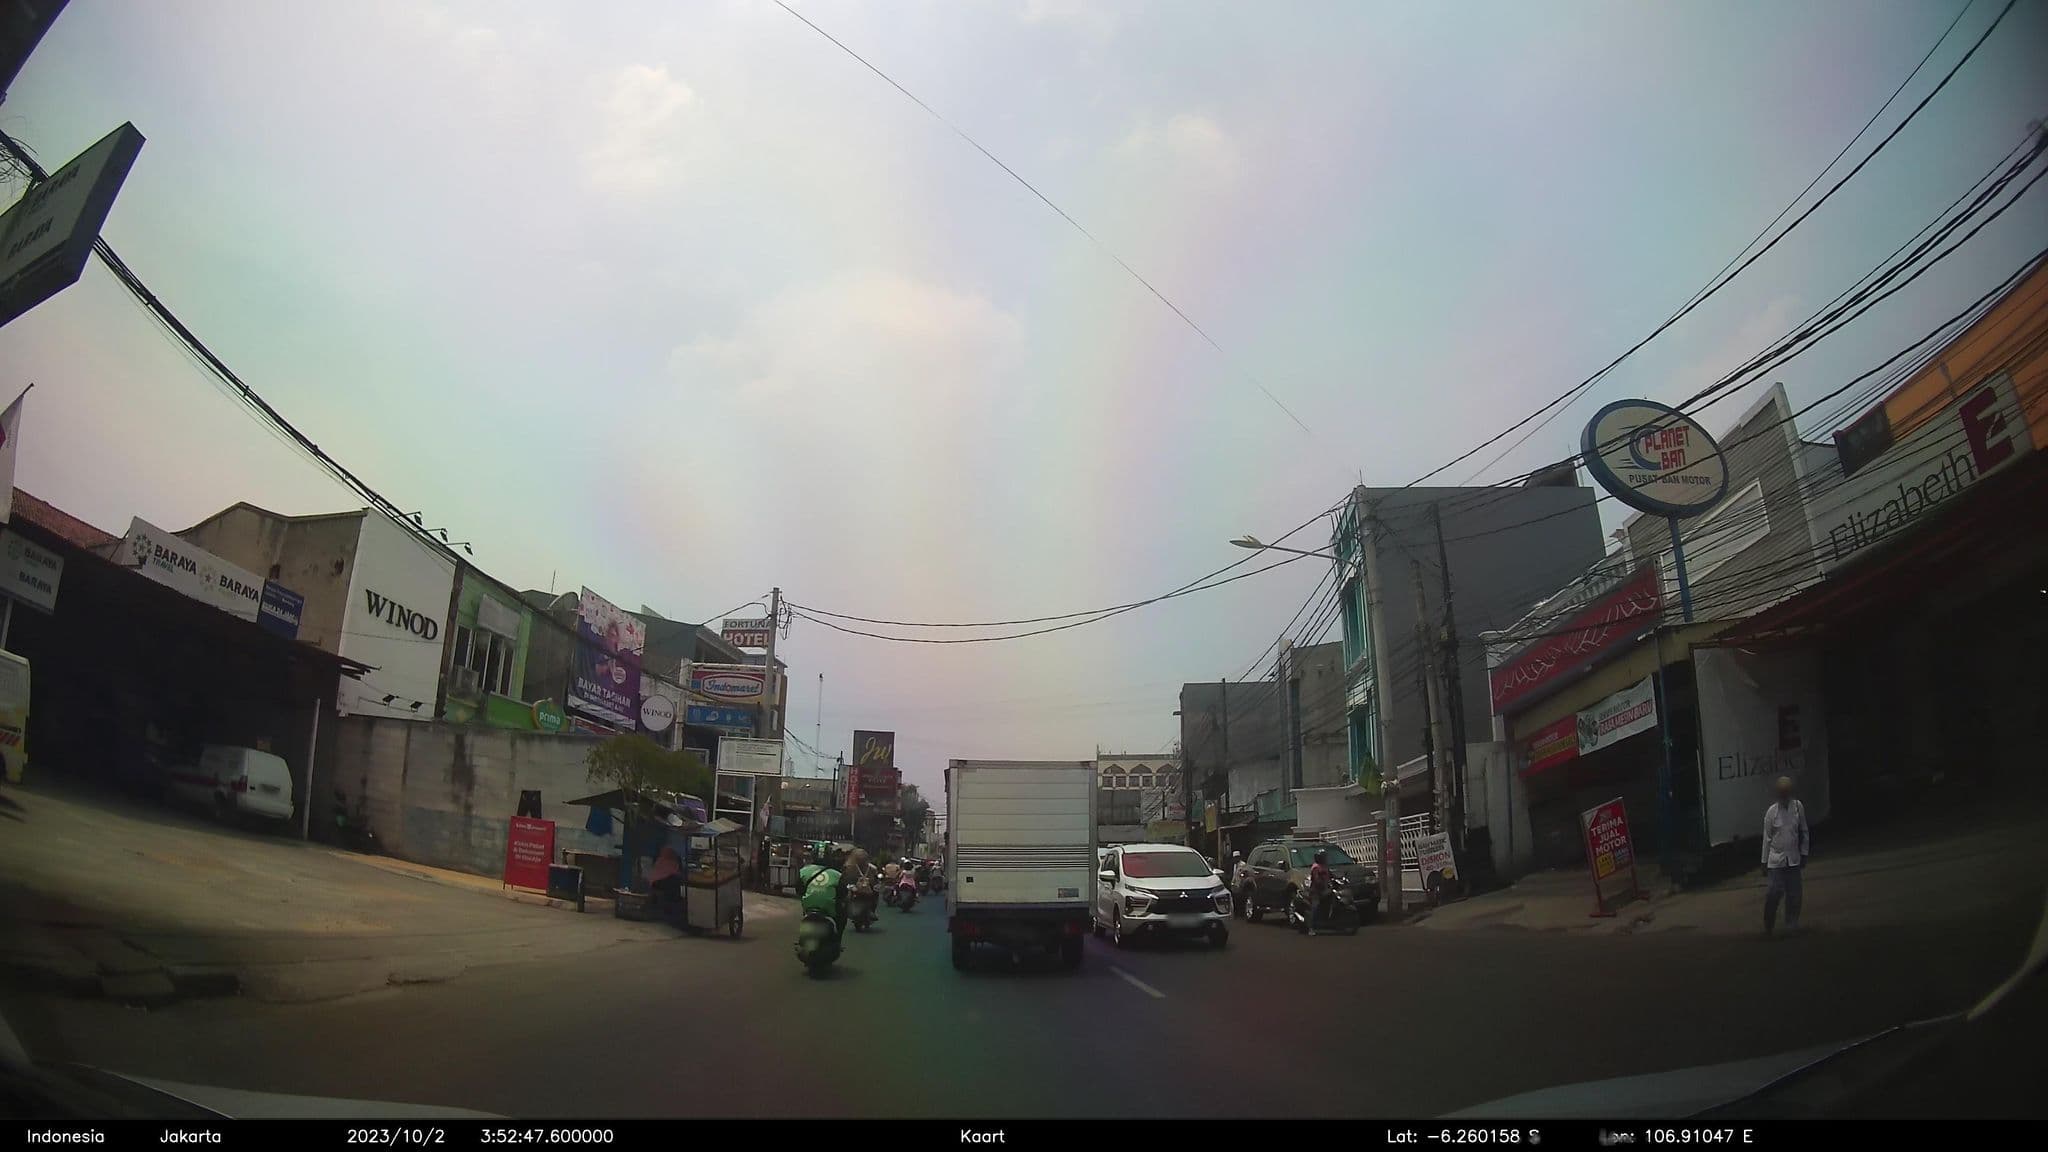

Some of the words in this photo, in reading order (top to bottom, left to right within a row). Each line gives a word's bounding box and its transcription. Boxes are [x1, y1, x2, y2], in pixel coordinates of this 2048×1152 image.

[1644, 425, 1690, 454] PLANET
[1661, 448, 1687, 470] BAN
[1628, 474, 1658, 484] PUSAT
[1661, 474, 1681, 485] BAN
[1681, 475, 1712, 487] MOTOR
[1829, 452, 1976, 562] Elizabeth
[153, 544, 197, 576] BARAYA
[219, 574, 260, 603] BARAYA
[365, 588, 439, 641] WINOD
[705, 680, 760, 694] Indomaret
[643, 707, 672, 719] WINOD
[1590, 816, 1624, 837] TERIMA
[1599, 828, 1621, 844] JUAL
[1595, 835, 1628, 857] MOTOR
